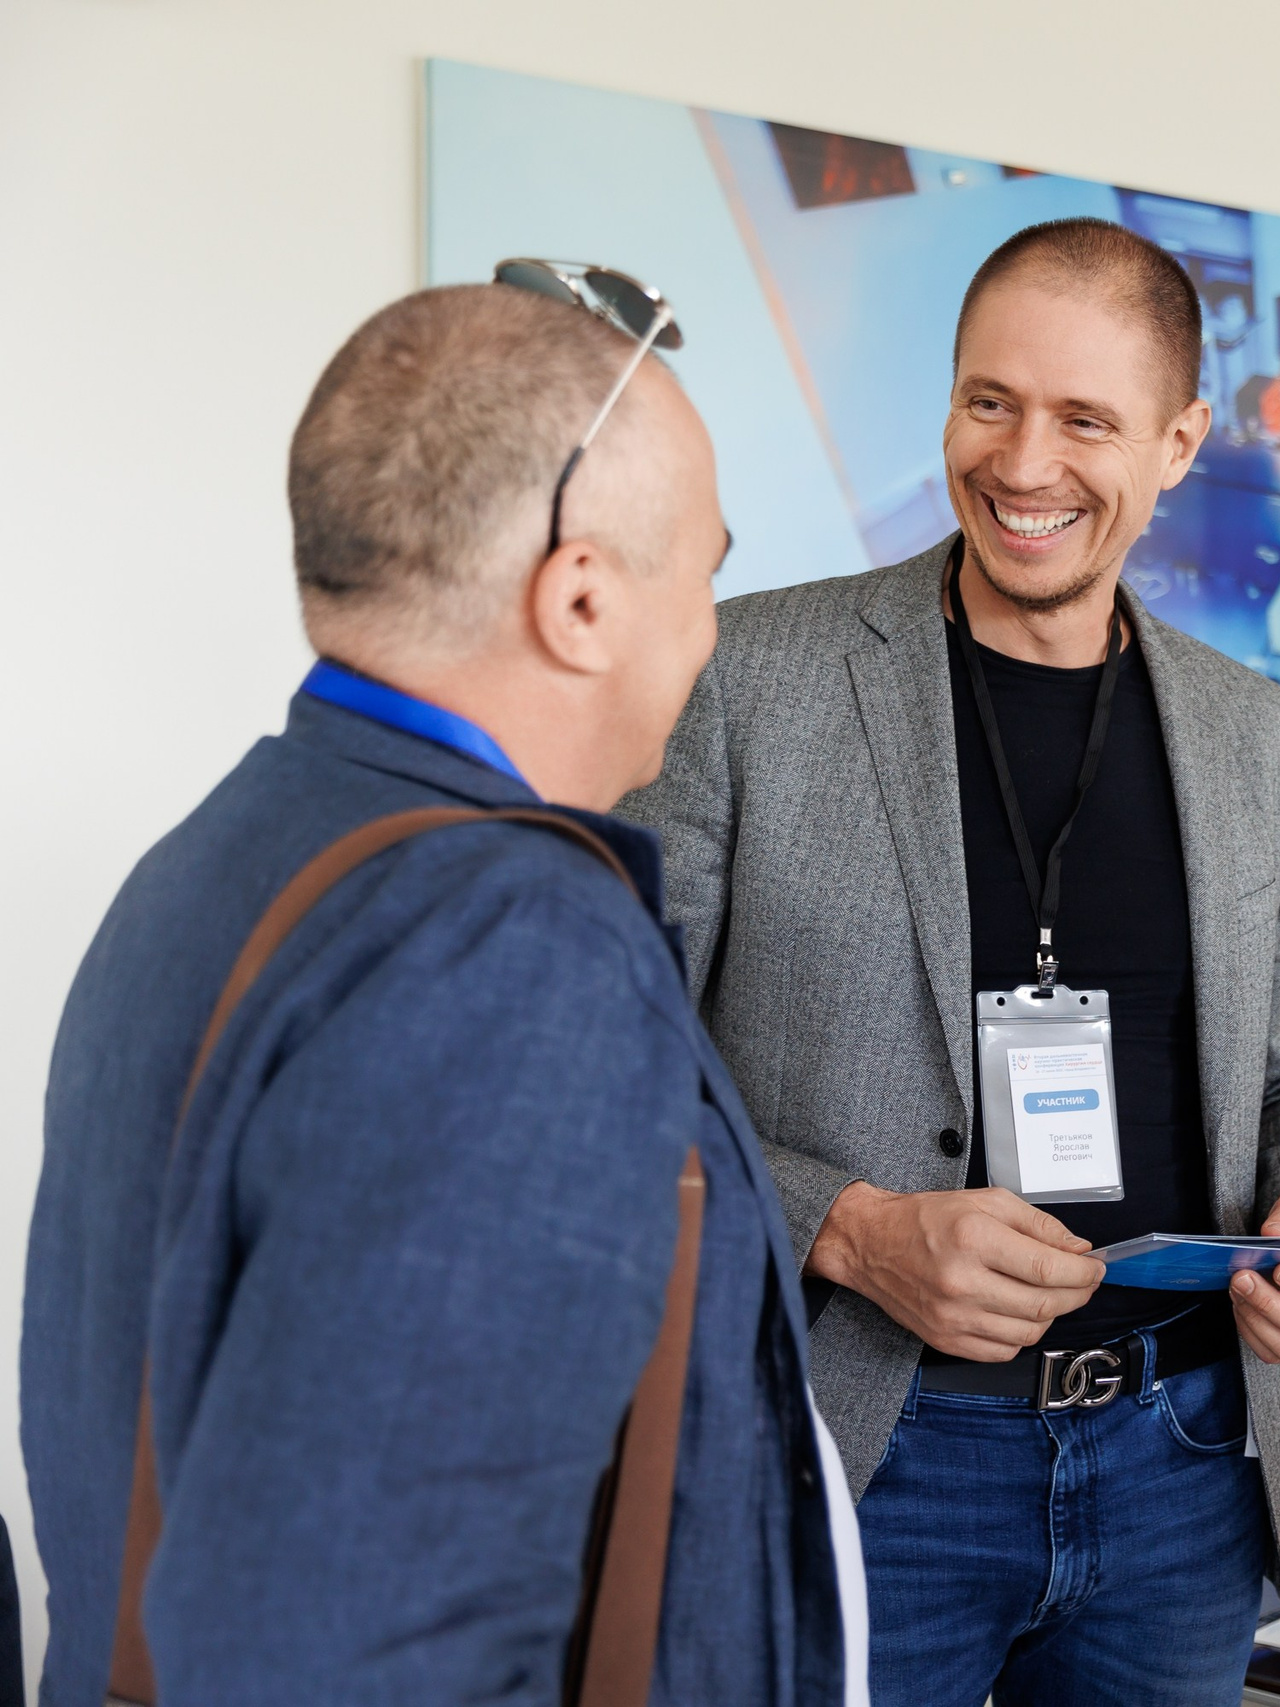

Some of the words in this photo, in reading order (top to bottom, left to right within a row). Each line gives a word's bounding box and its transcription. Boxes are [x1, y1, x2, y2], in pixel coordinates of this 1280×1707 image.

[1037, 1096, 1085, 1107] УЧАСТНИК
[1049, 1133, 1093, 1144] Третьяков
[1053, 1143, 1090, 1153] Ярослав
[1051, 1153, 1093, 1162] Олегович
